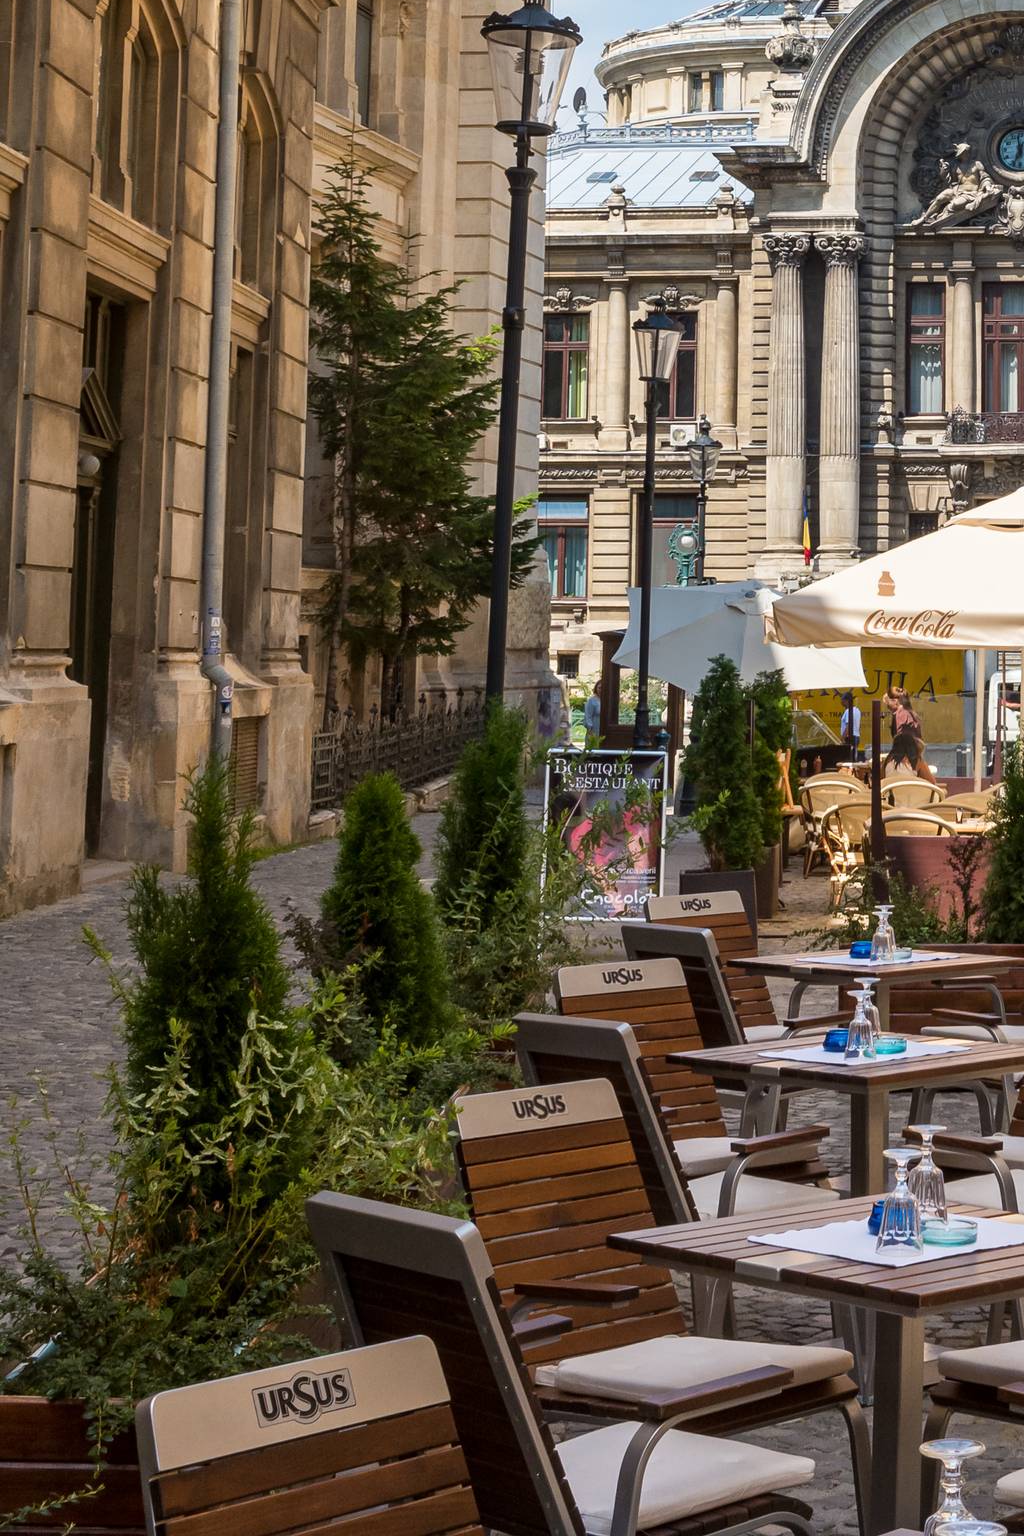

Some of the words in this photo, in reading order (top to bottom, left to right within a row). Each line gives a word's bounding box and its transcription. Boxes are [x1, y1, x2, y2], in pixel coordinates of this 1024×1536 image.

[863, 609, 960, 639] Coca-Cola
[680, 898, 711, 911] URSUS
[602, 968, 643, 985] URSUS
[511, 1094, 566, 1119] URSUS
[257, 1375, 350, 1421] URSUS
